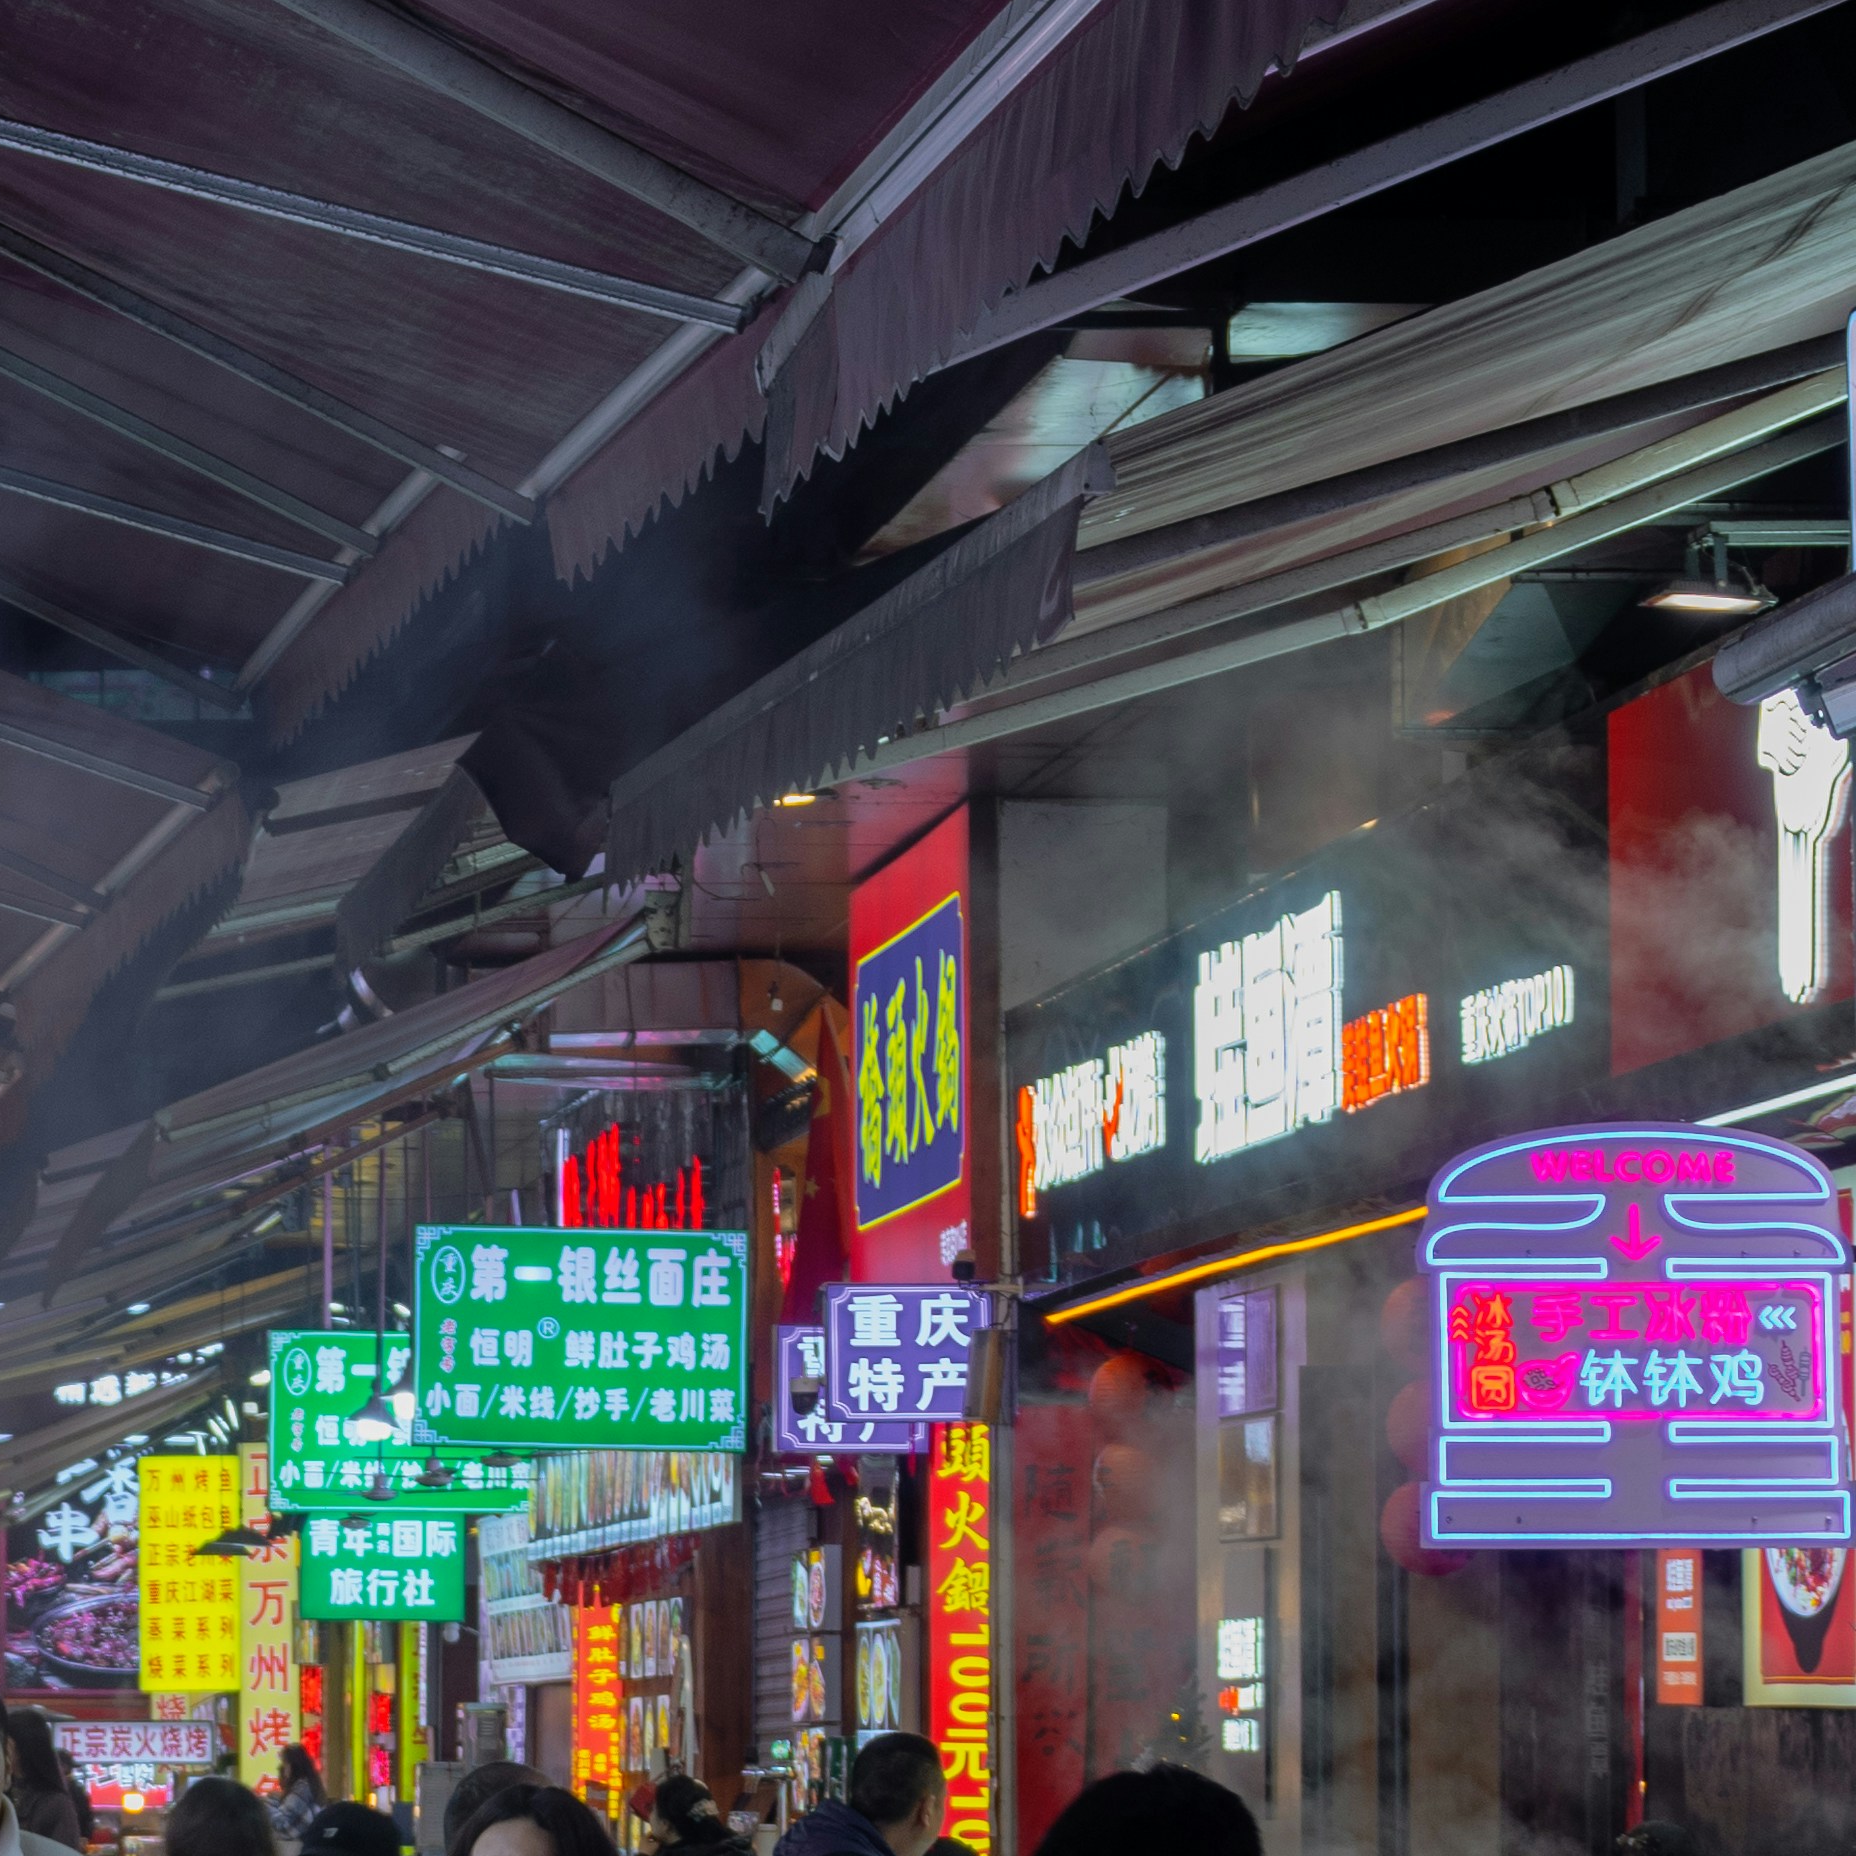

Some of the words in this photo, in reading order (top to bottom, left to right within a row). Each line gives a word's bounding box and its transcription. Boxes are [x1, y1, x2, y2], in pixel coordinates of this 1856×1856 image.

[1531, 1150, 1736, 1183] WELCOME
[470, 1244, 732, 1307] 第一银丝面庄
[847, 1293, 972, 1348] 重庆
[1531, 1287, 1752, 1344] 手工冰粉
[470, 1328, 534, 1368] 恒明
[565, 1330, 731, 1371] 鲜肚子鸡汤
[426, 1382, 736, 1423] 小面/米线/抄手/老川菜
[848, 1357, 969, 1412] 特产
[1580, 1349, 1764, 1407] 钵钵鸡
[330, 1568, 436, 1607] 旅行社
